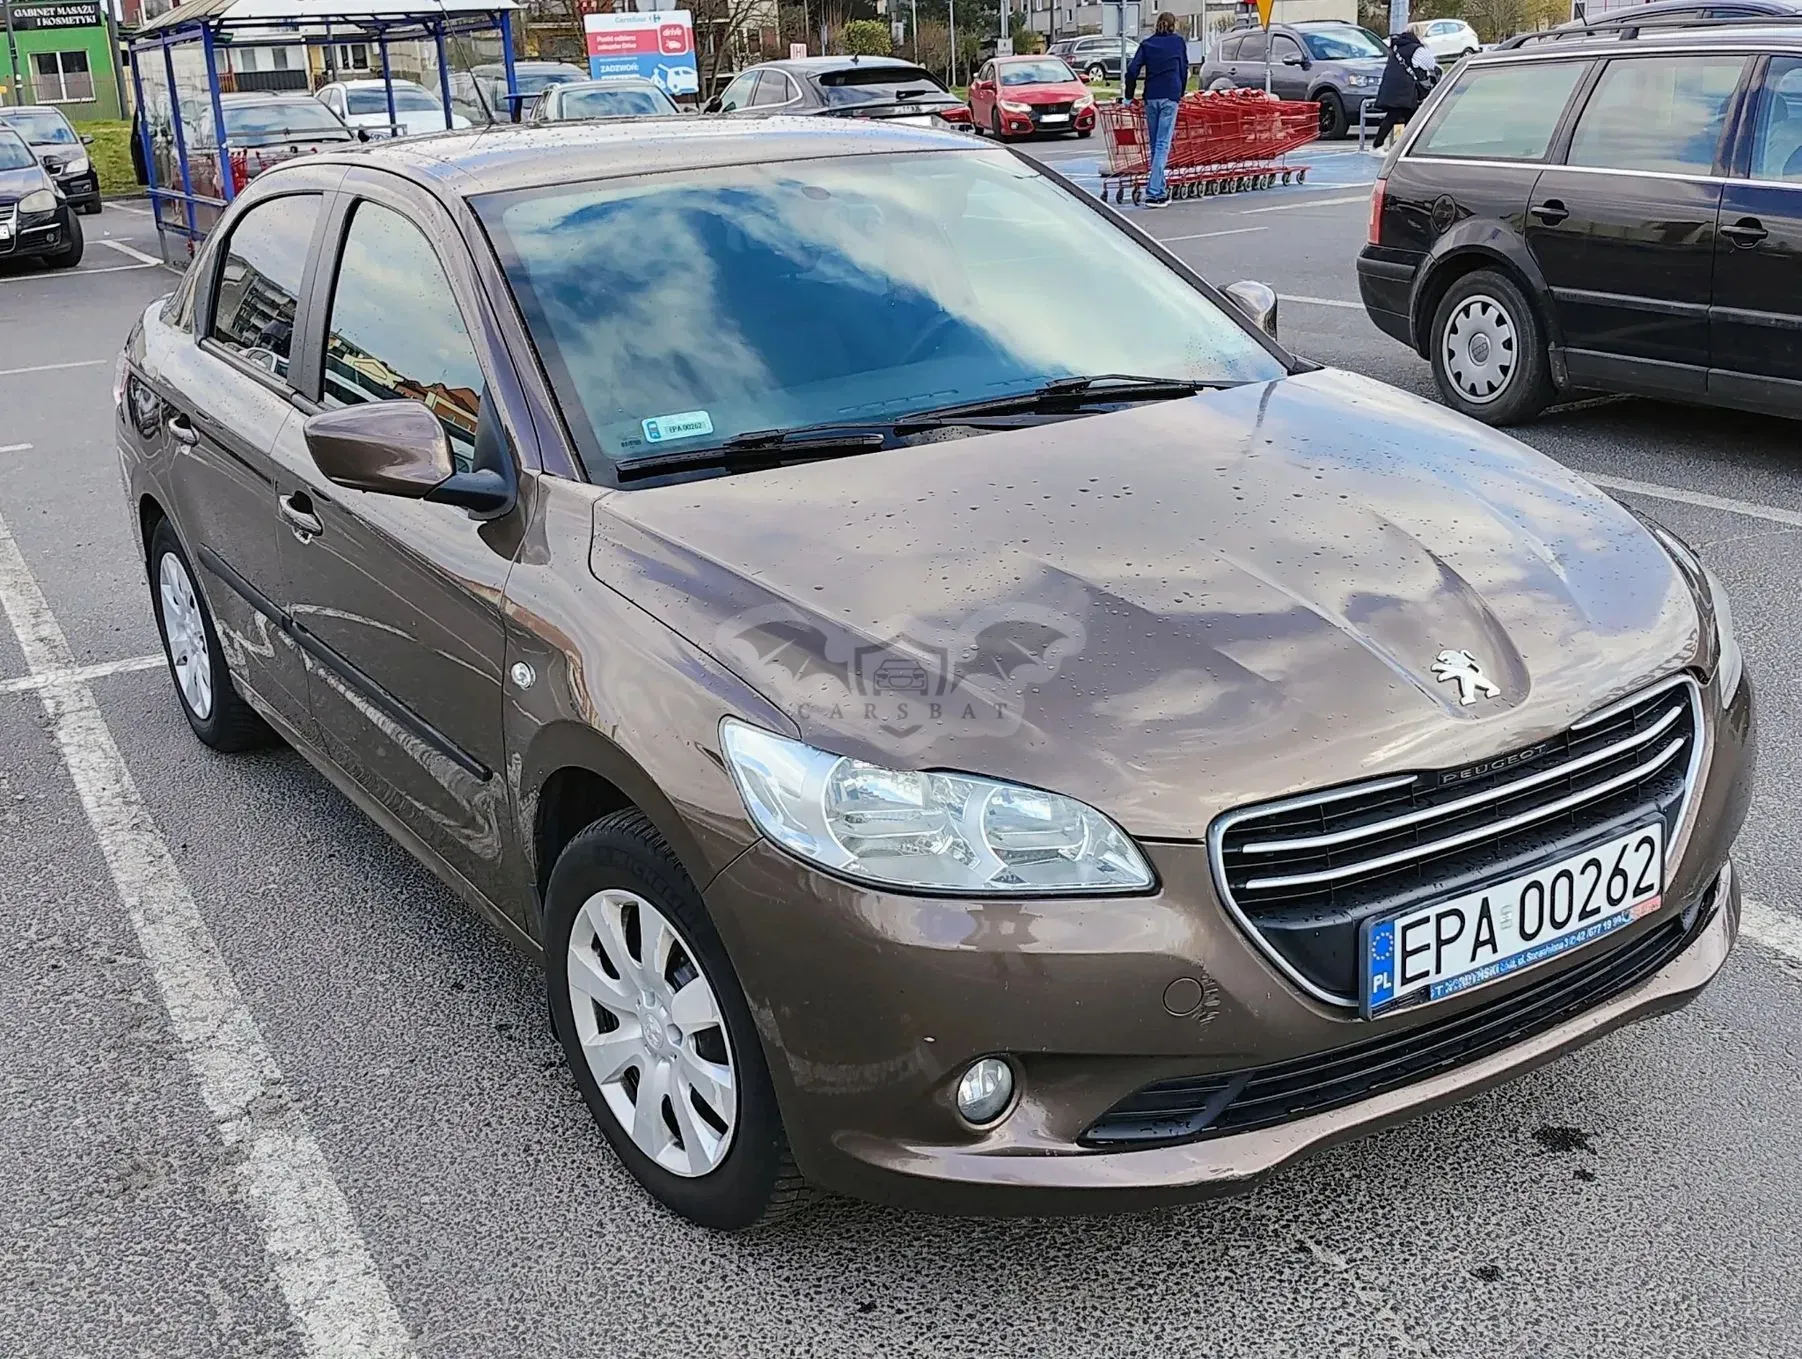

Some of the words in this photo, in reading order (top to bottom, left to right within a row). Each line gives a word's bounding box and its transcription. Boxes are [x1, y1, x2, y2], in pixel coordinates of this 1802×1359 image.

[14, 7, 55, 17] GABINET
[56, 4, 95, 15] MASAŻU
[37, 18, 41, 26] I
[42, 15, 97, 26] KOSMETYKI
[1442, 743, 1547, 783] PEUGEOT
[1400, 897, 1498, 987] EPA
[1519, 835, 1655, 941] 00262
[1373, 973, 1392, 993] PL
